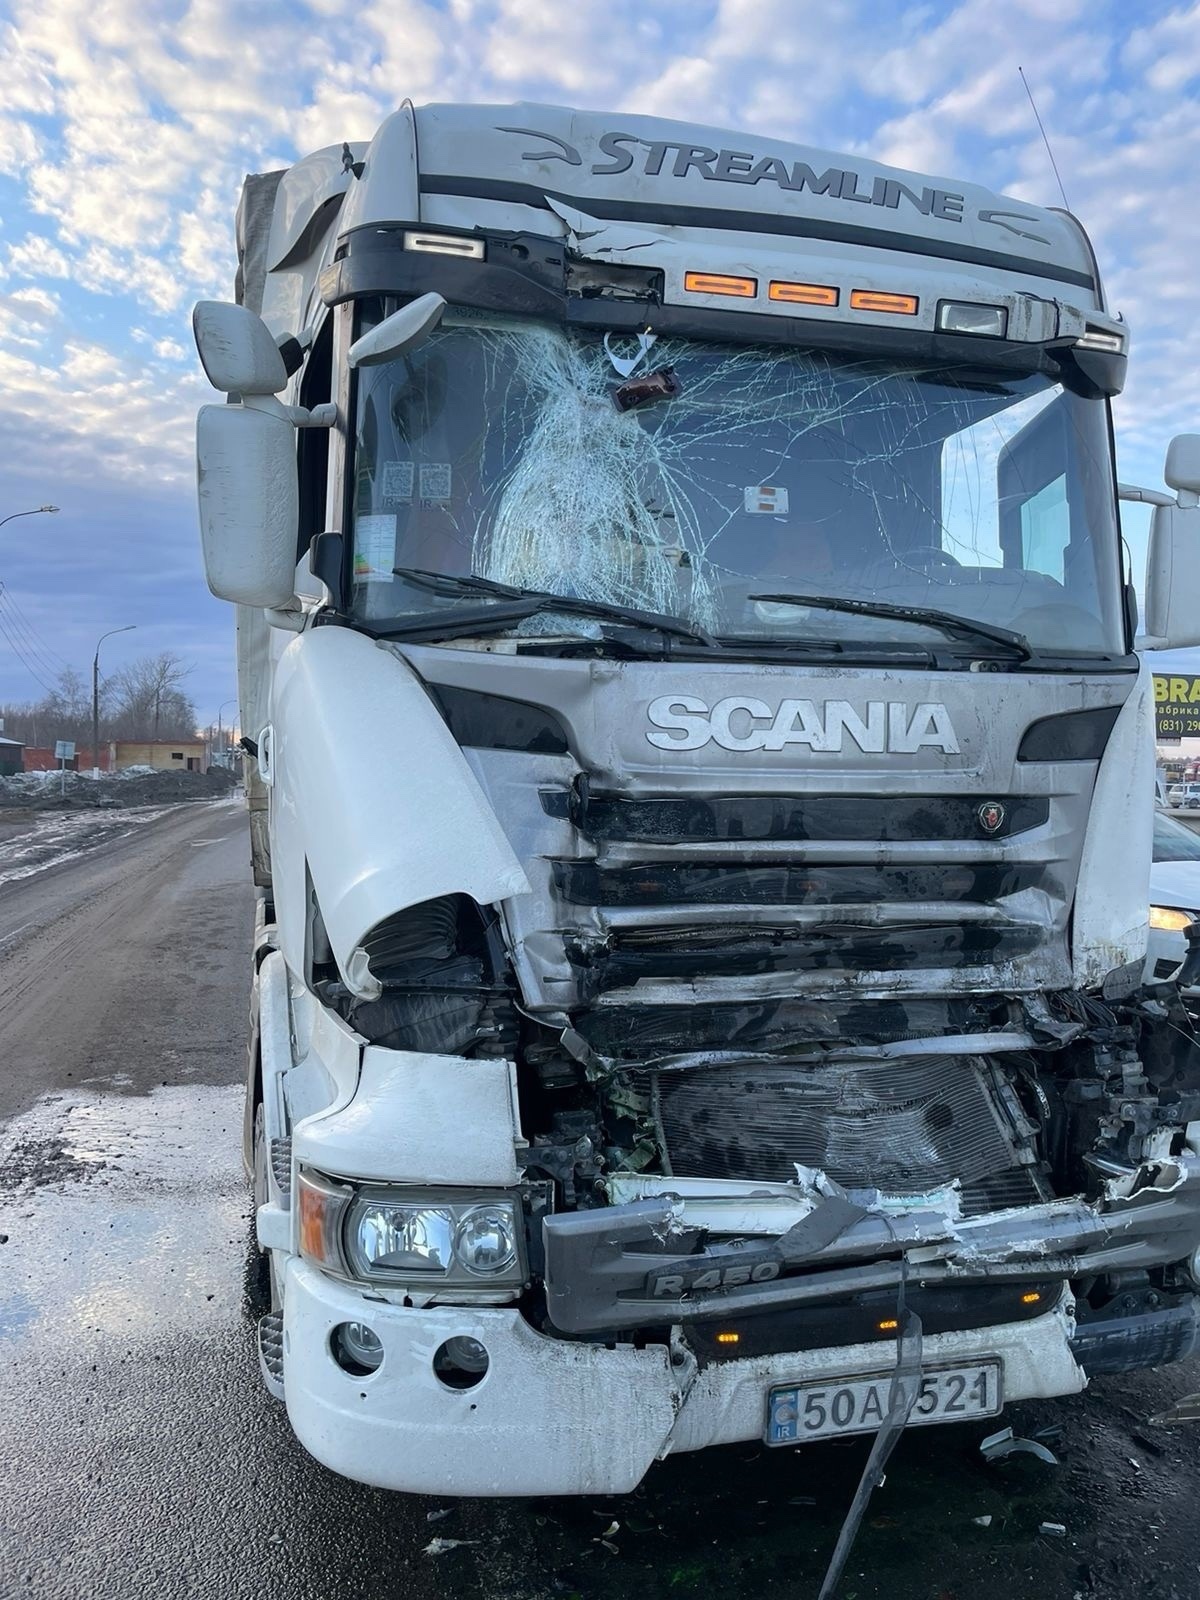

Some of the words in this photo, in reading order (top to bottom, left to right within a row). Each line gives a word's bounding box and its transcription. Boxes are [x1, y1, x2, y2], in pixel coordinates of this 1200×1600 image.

[592, 132, 964, 222] STREAMLINE
[645, 694, 961, 754] SCANIA
[1159, 719, 1184, 734] (831)
[1187, 720, 1200, 731] 29
[654, 1275, 684, 1296] R
[692, 1262, 780, 1289] 450
[777, 1426, 790, 1438] IR
